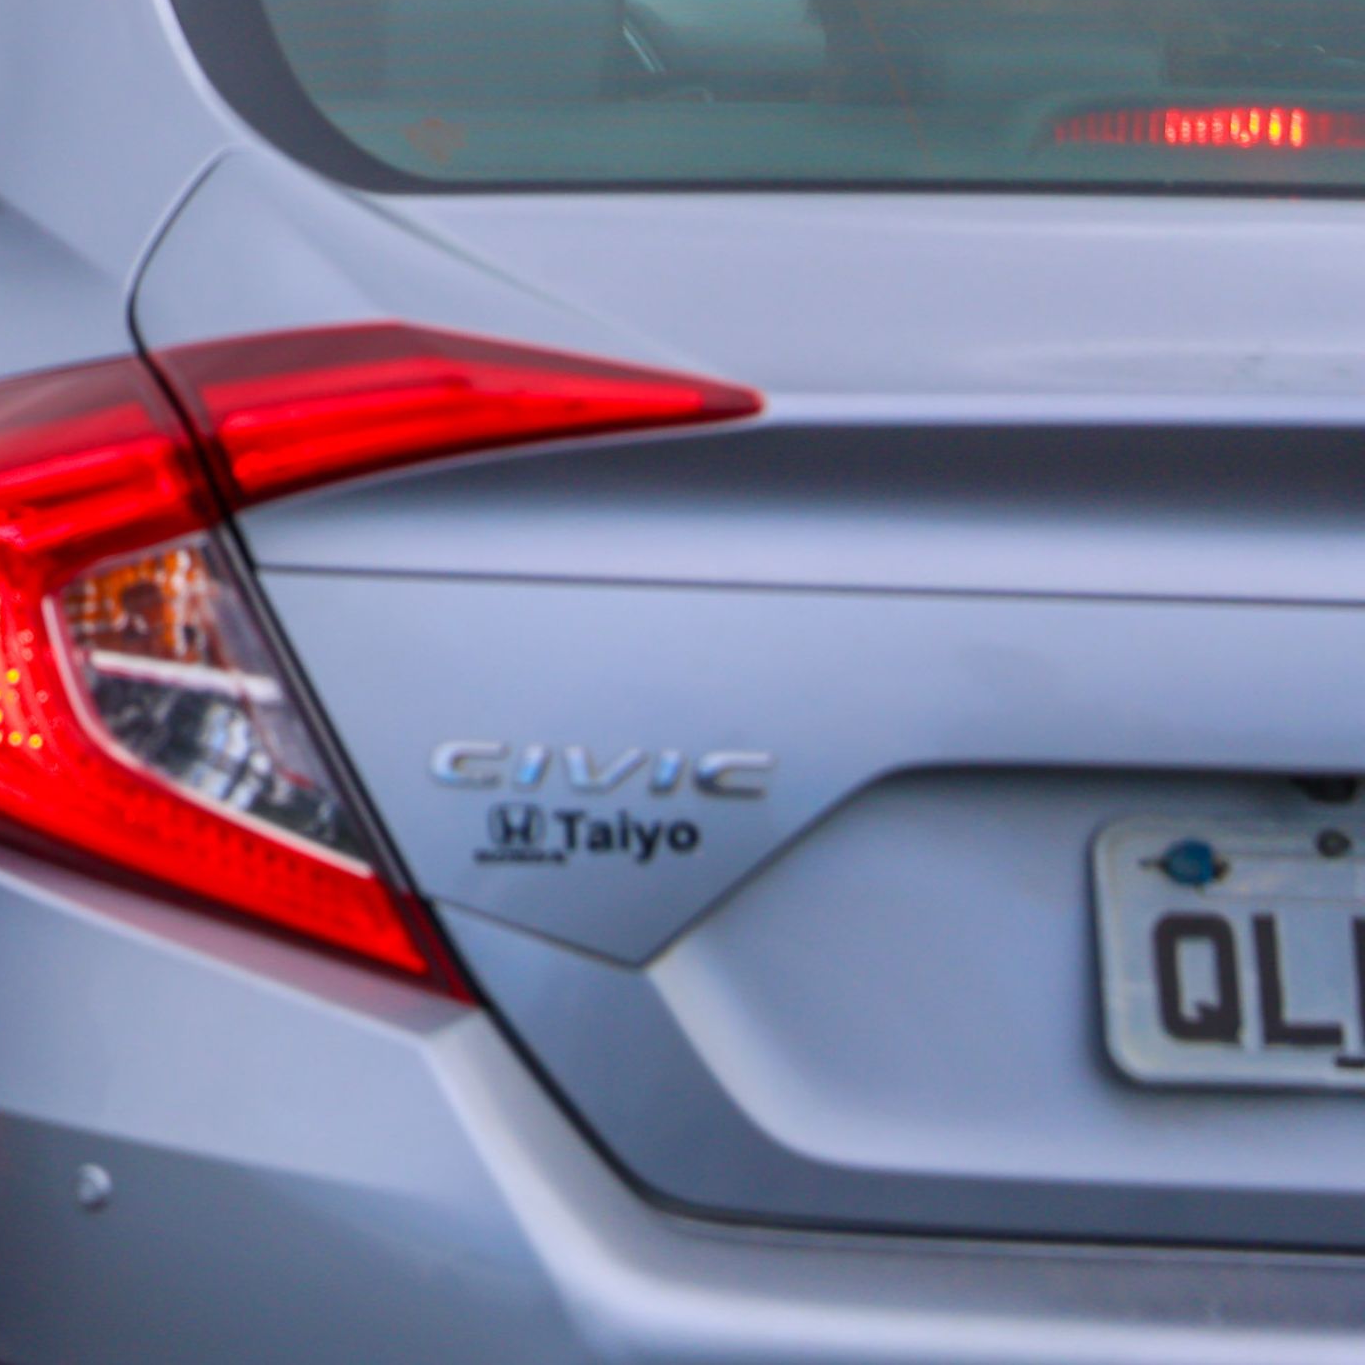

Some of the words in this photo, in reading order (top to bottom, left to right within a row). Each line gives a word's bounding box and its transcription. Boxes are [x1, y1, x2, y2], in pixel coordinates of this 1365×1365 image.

[430, 739, 776, 800] CIVIC
[553, 808, 700, 864] Taiyo
[1151, 909, 1365, 1049] QL
